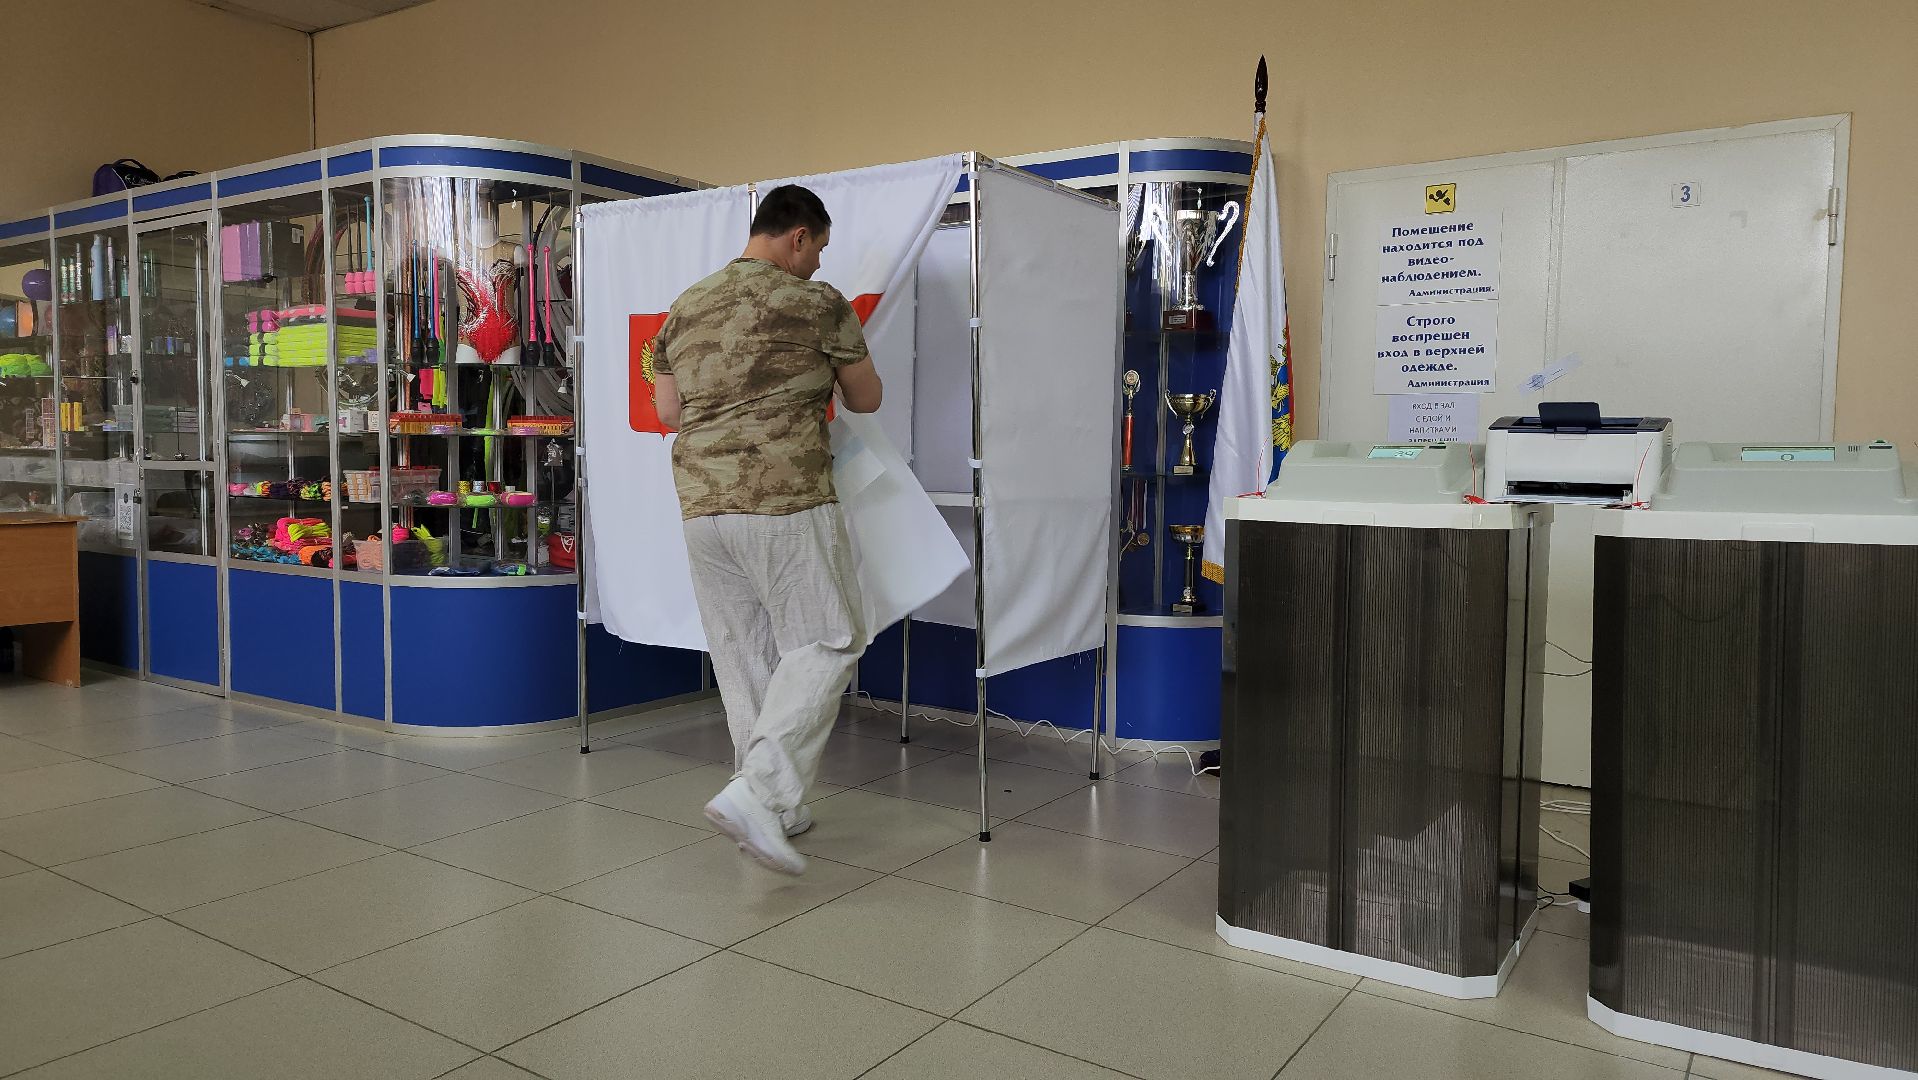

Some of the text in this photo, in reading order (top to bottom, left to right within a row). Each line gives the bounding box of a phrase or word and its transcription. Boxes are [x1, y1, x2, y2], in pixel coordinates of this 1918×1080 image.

[1680, 185, 1691, 203] 3
[1382, 237, 1485, 254] находится под
[1407, 256, 1455, 267] видео-
[1381, 269, 1482, 284] наблюдением.
[1408, 286, 1495, 297] Администрация.
[1406, 316, 1456, 329] Строго
[1377, 344, 1485, 359] вход в верхней
[1401, 363, 1458, 373] одежде.
[1407, 379, 1490, 388] Администрация
[1412, 402, 1433, 410] ВХОД
[1440, 401, 1455, 409] ЗАЛ
[1422, 413, 1444, 422] ЕДОЙ
[1445, 414, 1451, 422] И
[1409, 426, 1457, 434] НАПИТКАМИ
